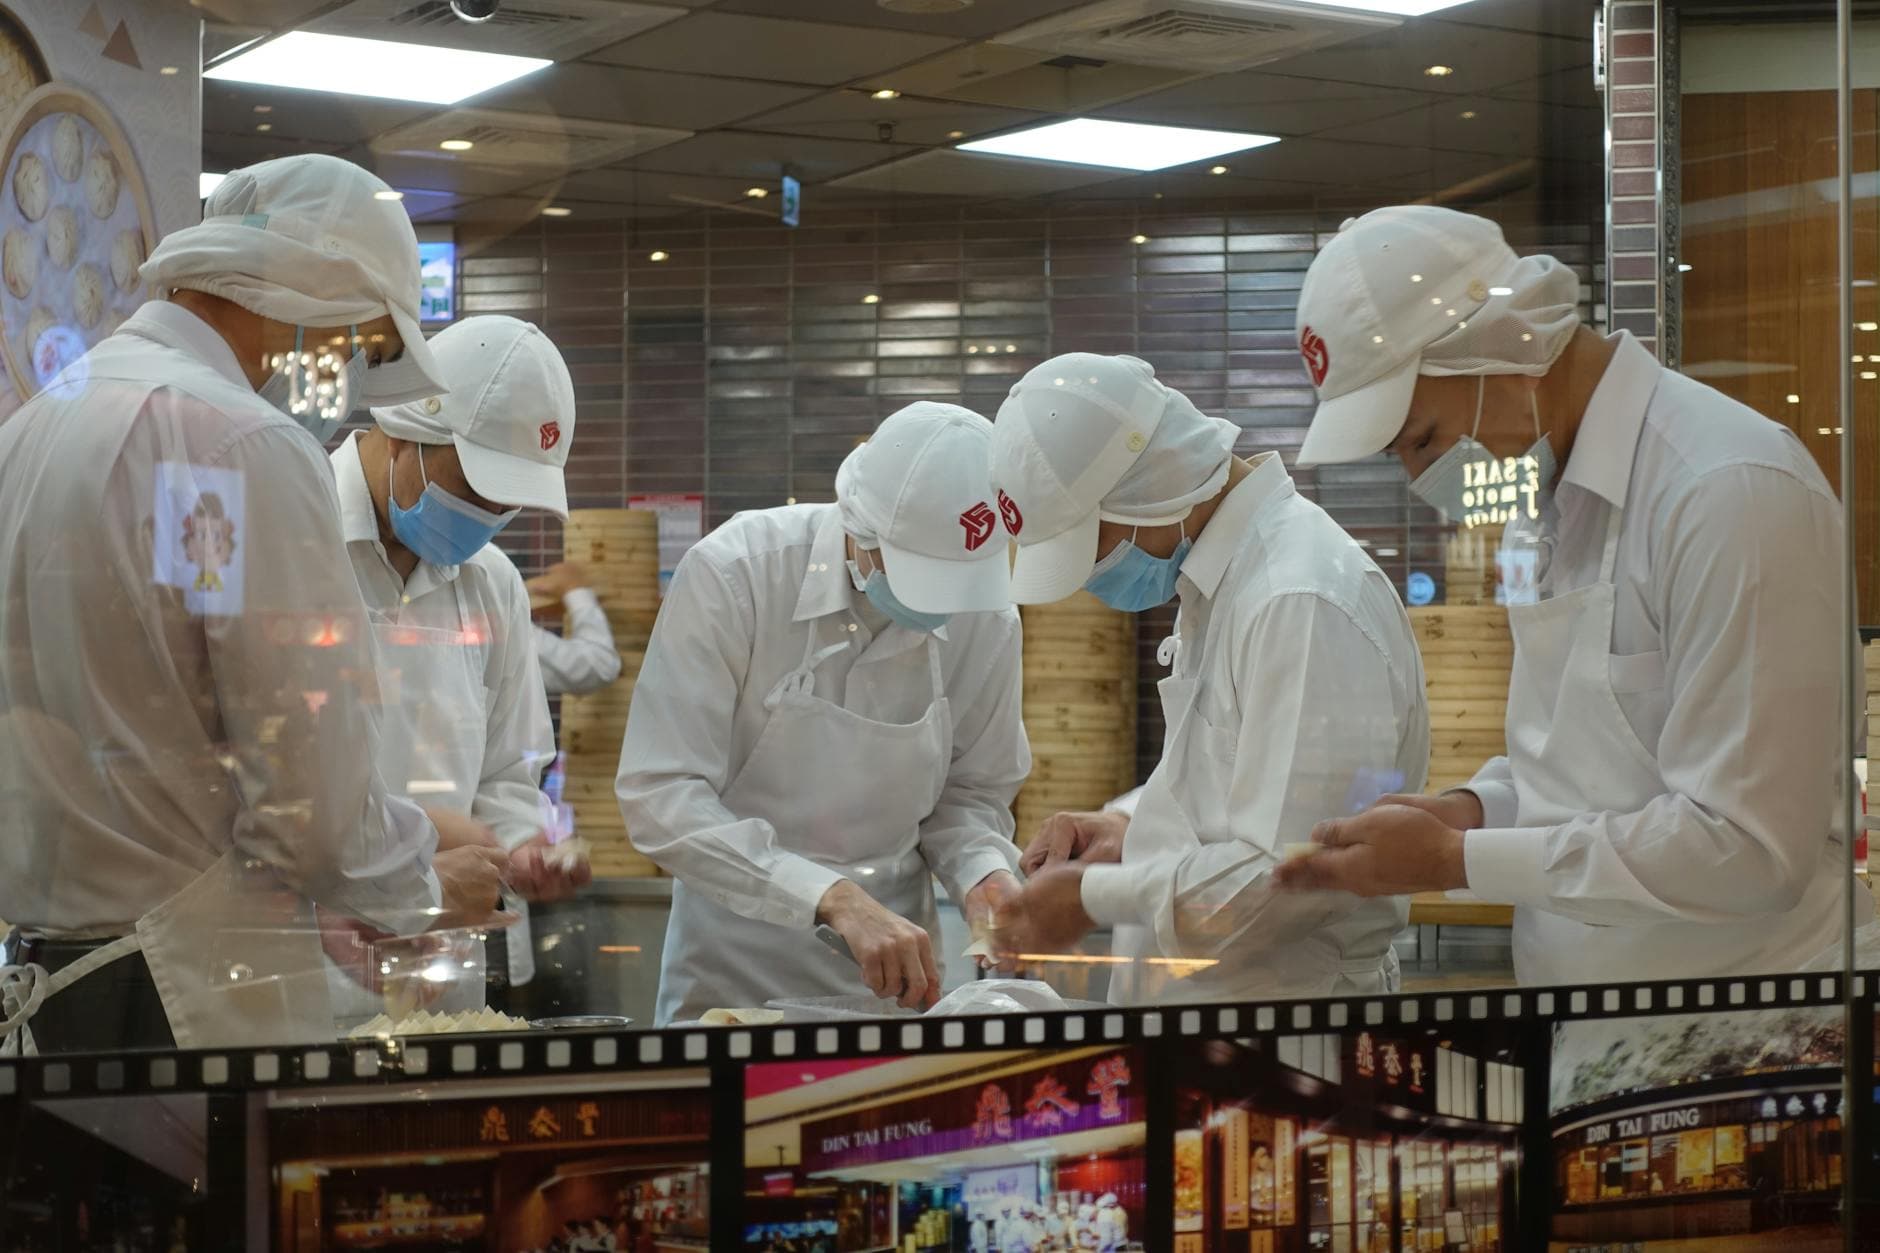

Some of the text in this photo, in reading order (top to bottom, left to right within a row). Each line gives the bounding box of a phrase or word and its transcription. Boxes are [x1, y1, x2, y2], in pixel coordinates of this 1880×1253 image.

[822, 1118, 934, 1153] DIN TAI FUNG
[1587, 1107, 1700, 1144] DIN TAI FUNG
